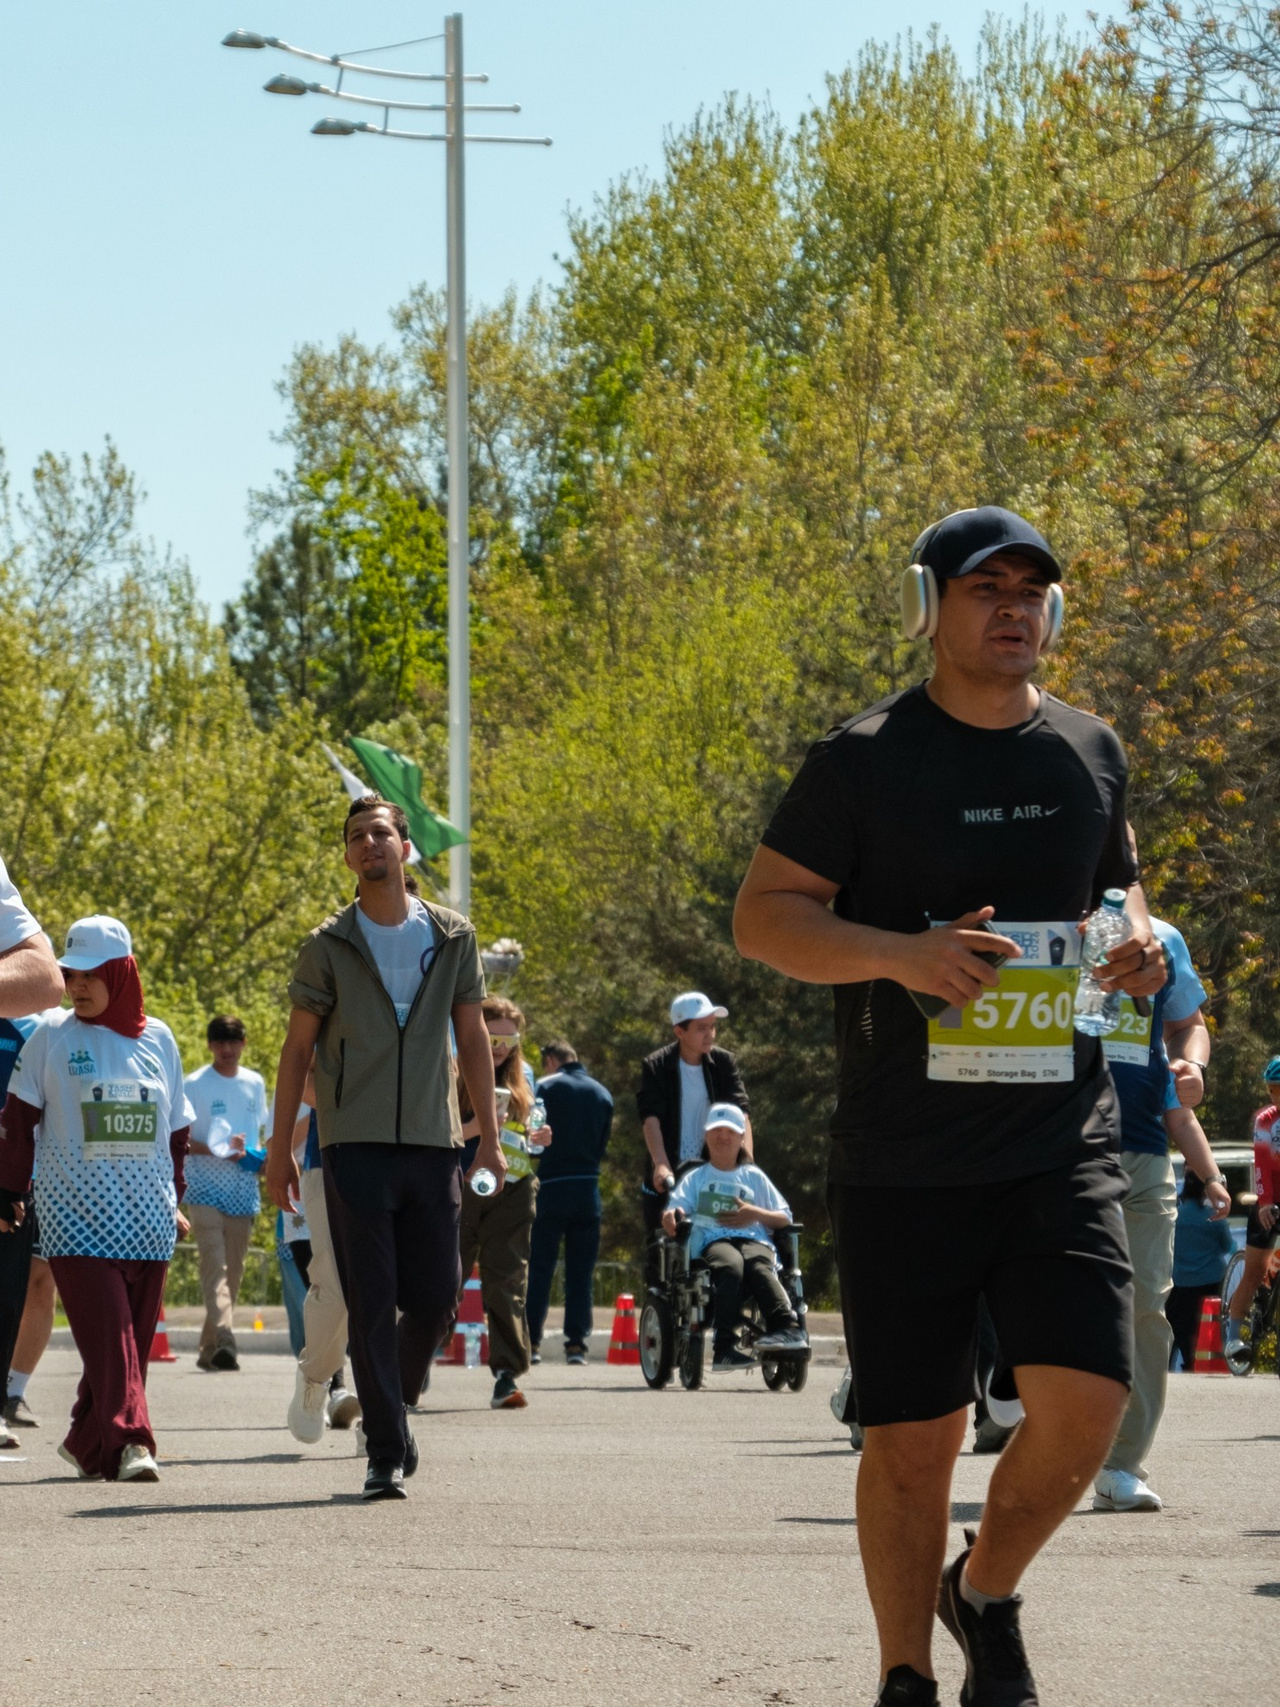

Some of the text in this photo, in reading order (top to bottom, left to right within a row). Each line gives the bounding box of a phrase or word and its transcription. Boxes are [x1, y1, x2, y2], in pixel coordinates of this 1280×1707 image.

[964, 805, 1043, 822] NIKE AIR
[973, 991, 1072, 1030] 5760
[1122, 1012, 1149, 1035] 23
[958, 1068, 979, 1077] 5760
[986, 1069, 1019, 1079] Storage
[1020, 1069, 1037, 1079] Bag
[103, 1113, 154, 1134] 10375
